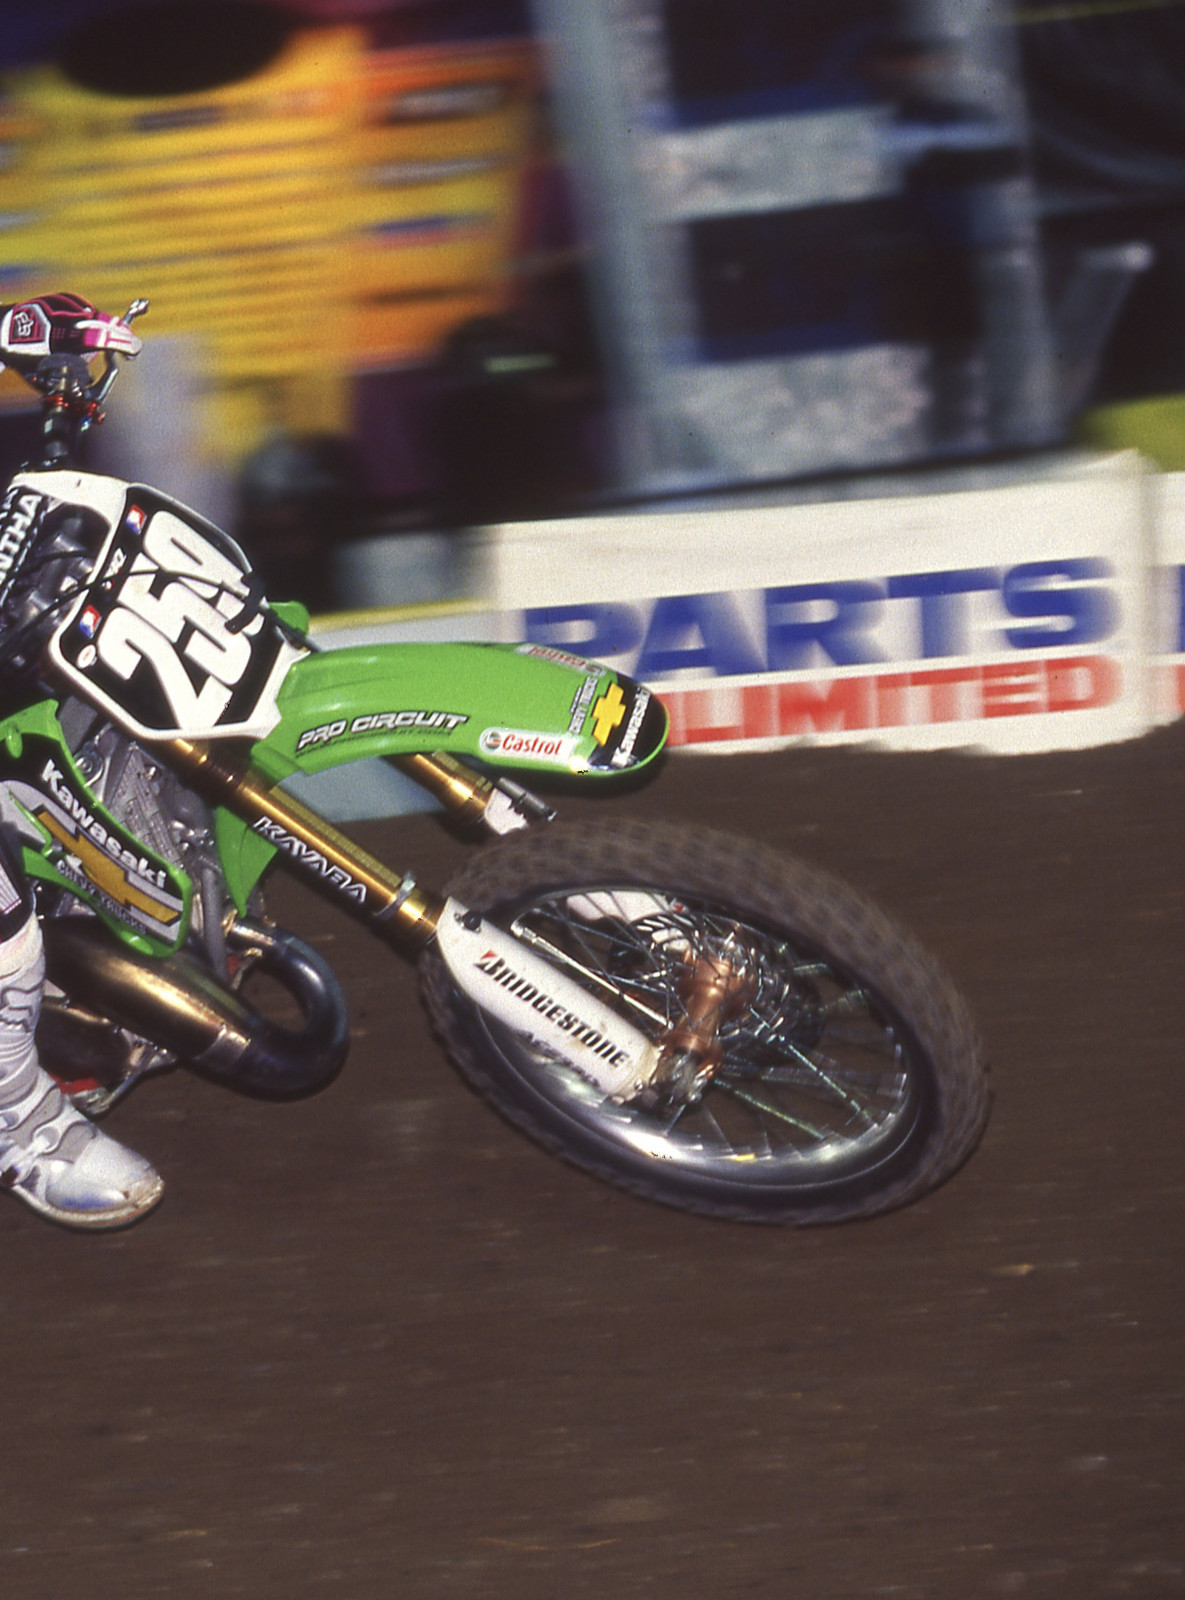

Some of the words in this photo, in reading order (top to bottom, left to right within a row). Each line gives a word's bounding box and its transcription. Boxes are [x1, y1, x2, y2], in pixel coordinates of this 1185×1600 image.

[98, 510, 265, 730] 259
[522, 556, 1122, 680] PARTS
[296, 719, 348, 751] PRO
[350, 710, 472, 733] CIRCUIT
[502, 733, 562, 757] Castrol
[666, 655, 1123, 746] LIMITED
[41, 758, 167, 889] Kawasaki
[474, 949, 631, 1068] BRIDGESTONE
